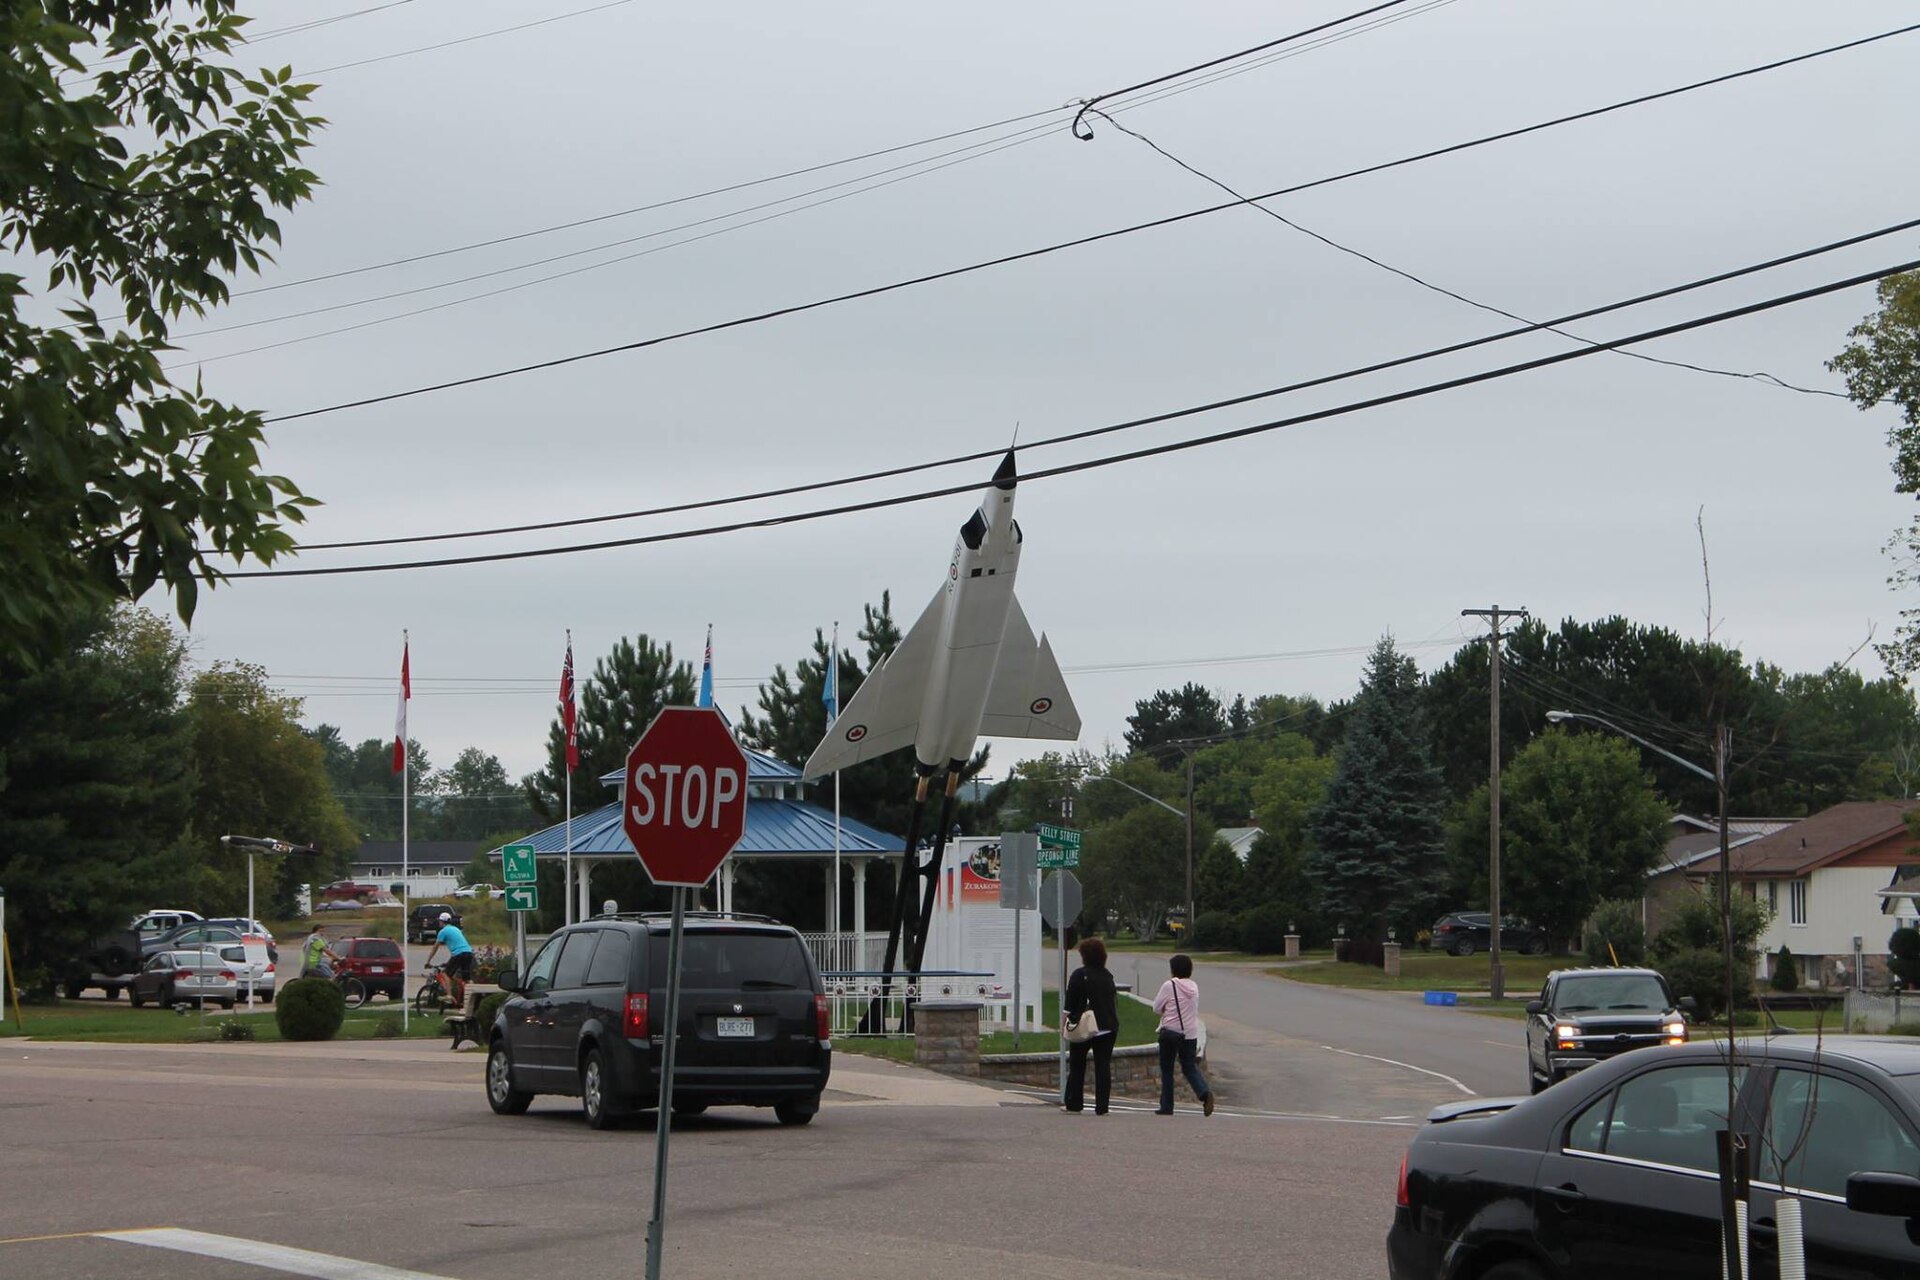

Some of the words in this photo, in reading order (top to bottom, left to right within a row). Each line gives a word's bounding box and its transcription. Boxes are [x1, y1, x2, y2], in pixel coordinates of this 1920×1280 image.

[631, 762, 739, 829] STOP
[1041, 825, 1058, 839] KELLY
[1059, 829, 1080, 844] STREET
[1038, 850, 1064, 862] OPEONGO
[1065, 848, 1079, 860] LINE
[507, 857, 518, 872] A
